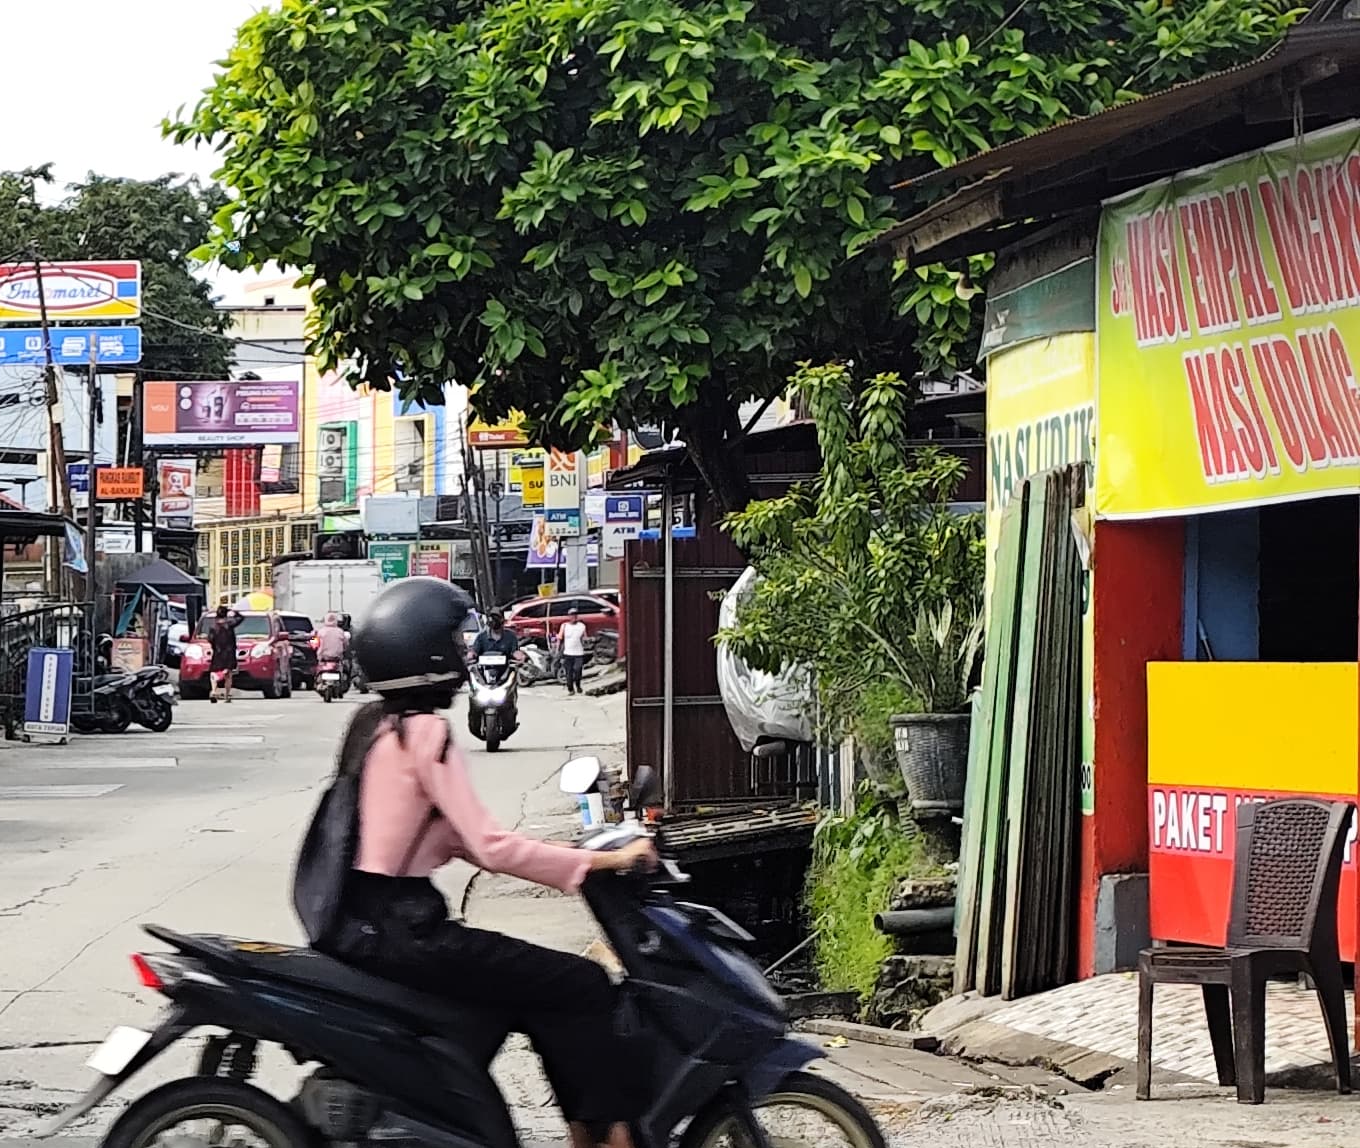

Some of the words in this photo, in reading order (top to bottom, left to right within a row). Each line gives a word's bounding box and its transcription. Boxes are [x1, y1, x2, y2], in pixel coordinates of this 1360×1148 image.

[1126, 207, 1191, 343] NASI
[1179, 186, 1282, 331] EMPAL
[1184, 346, 1280, 479] NASI
[550, 474, 576, 487] BNI
[989, 424, 1031, 512] NASI
[550, 513, 567, 521] ATM
[613, 527, 636, 535] ATM
[1153, 790, 1228, 853] PAKET
